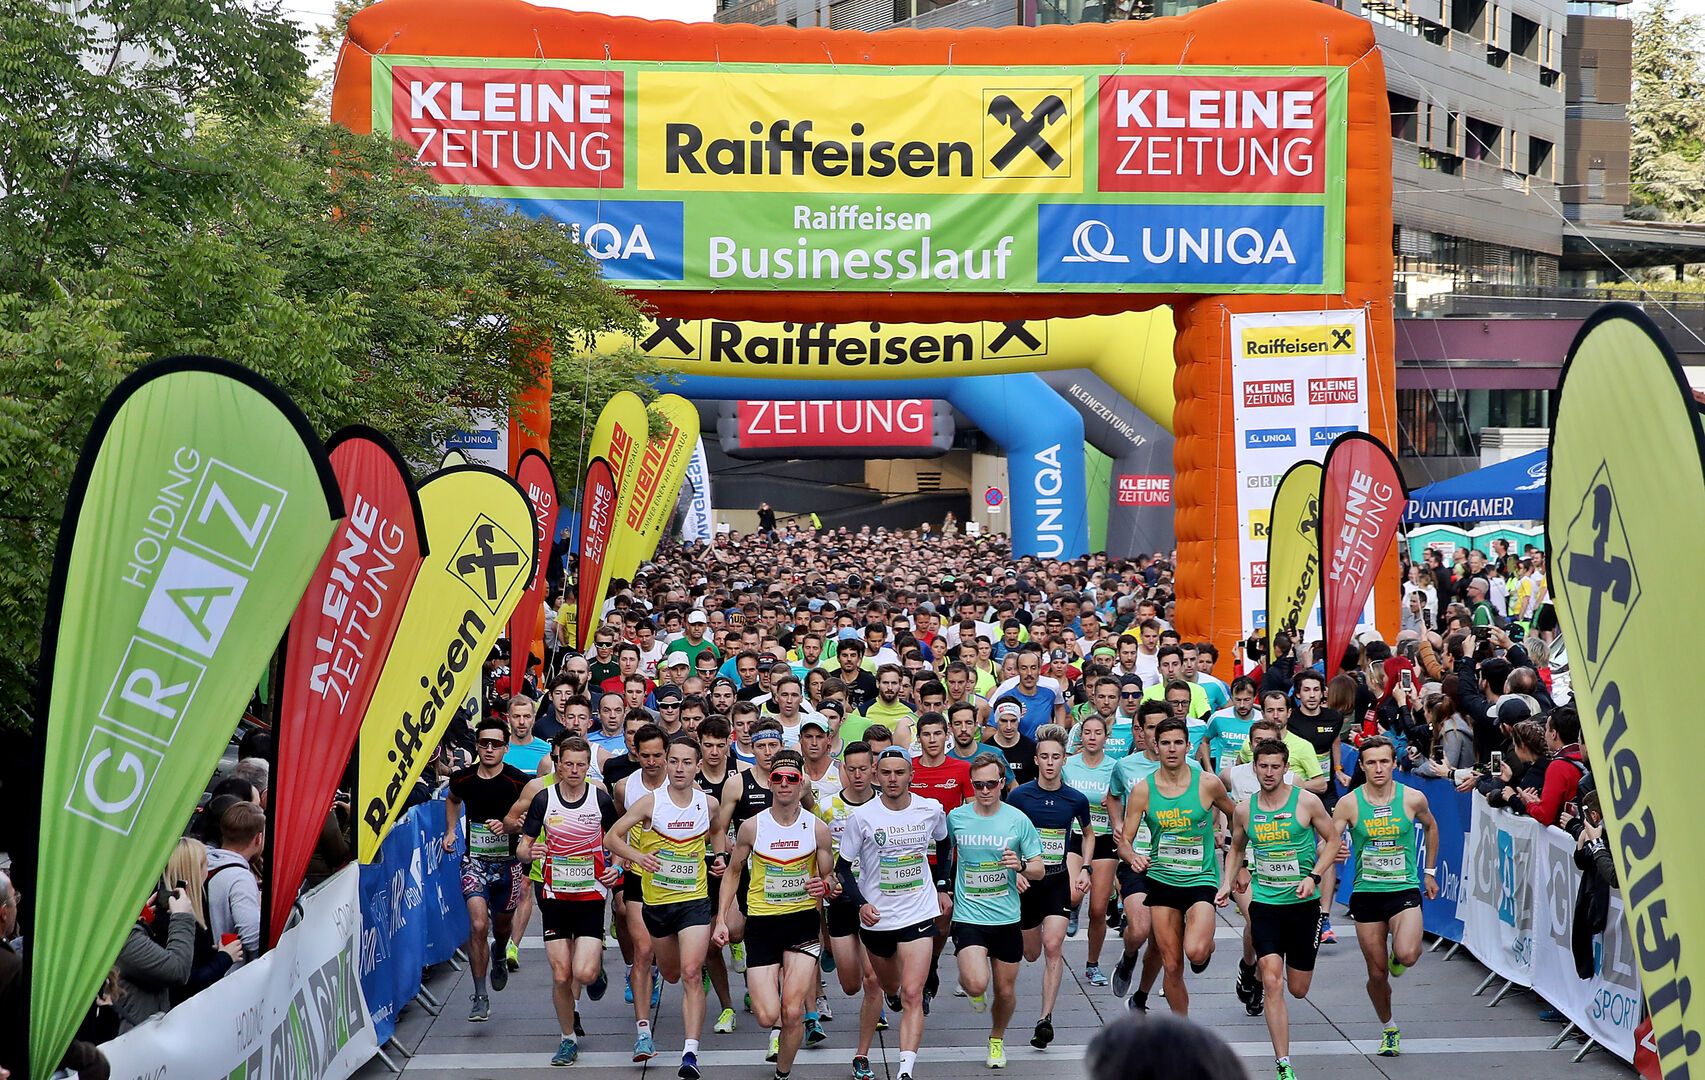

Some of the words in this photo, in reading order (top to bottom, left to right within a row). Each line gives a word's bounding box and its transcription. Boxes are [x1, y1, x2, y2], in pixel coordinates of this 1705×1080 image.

[410, 81, 612, 124] KLEINE
[1116, 89, 1314, 129] KLEINE
[413, 128, 612, 171] ZEITUNG
[665, 119, 973, 178] Raiffeisen
[1115, 136, 1314, 177] ZEITUNG
[794, 205, 932, 232] Raiffeisen
[557, 221, 656, 260] IQA
[1142, 226, 1296, 265] UNIQA
[709, 234, 1013, 281] Businesslauf
[709, 321, 974, 366] Raiffeisen
[1246, 338, 1329, 355] Raiffeisen
[1245, 383, 1292, 394] KLEINE
[1310, 380, 1356, 391] KLEINE
[1246, 393, 1293, 405] ZEITUNG
[1311, 390, 1357, 402] ZEITUNG
[747, 399, 924, 434] ZEITUNG
[1069, 383, 1147, 447] KLEINEZEITUNG.AT
[464, 435, 493, 444] UNIQA
[1263, 433, 1292, 442] UNIQA
[628, 441, 640, 477] VORAUS
[655, 484, 667, 507] EINEN
[663, 471, 672, 485] HIT
[670, 431, 688, 469] VORAUS
[1119, 479, 1170, 490] KLEINE
[1248, 476, 1281, 487] GRA
[1034, 443, 1064, 558] UNIQA
[1119, 490, 1170, 503] ZEITUNG
[121, 445, 201, 589] HOLDING
[585, 482, 605, 559] KLEINE
[592, 488, 612, 565] ZEITUNG
[1330, 470, 1373, 582] KLEINE
[1343, 480, 1393, 595] ZEITUNG
[322, 518, 405, 714] ZEITUNG
[83, 481, 271, 815] GRAZ
[364, 608, 488, 837] Raiffeisen
[1156, 808, 1180, 820] well
[667, 820, 694, 829] antenne
[889, 825, 905, 834] Das
[906, 823, 926, 832] Land
[1158, 816, 1192, 829] wash
[1254, 821, 1278, 833] well
[1363, 816, 1389, 828] well
[1256, 829, 1290, 842] wash
[1366, 824, 1400, 837] wash
[480, 835, 508, 844] 1854C
[770, 839, 799, 849] antenne
[889, 835, 927, 846] Steiermark
[1175, 847, 1199, 856] 381B
[1269, 864, 1295, 872] 381A
[1376, 857, 1401, 866] 381C
[564, 868, 594, 877] 1809C
[670, 864, 694, 874] 283B
[894, 866, 922, 879] 1692B
[665, 876, 685, 884] Florian
[781, 879, 806, 888] 283A
[978, 873, 1007, 883] 1062A
[1593, 988, 1637, 1030] SPORT
